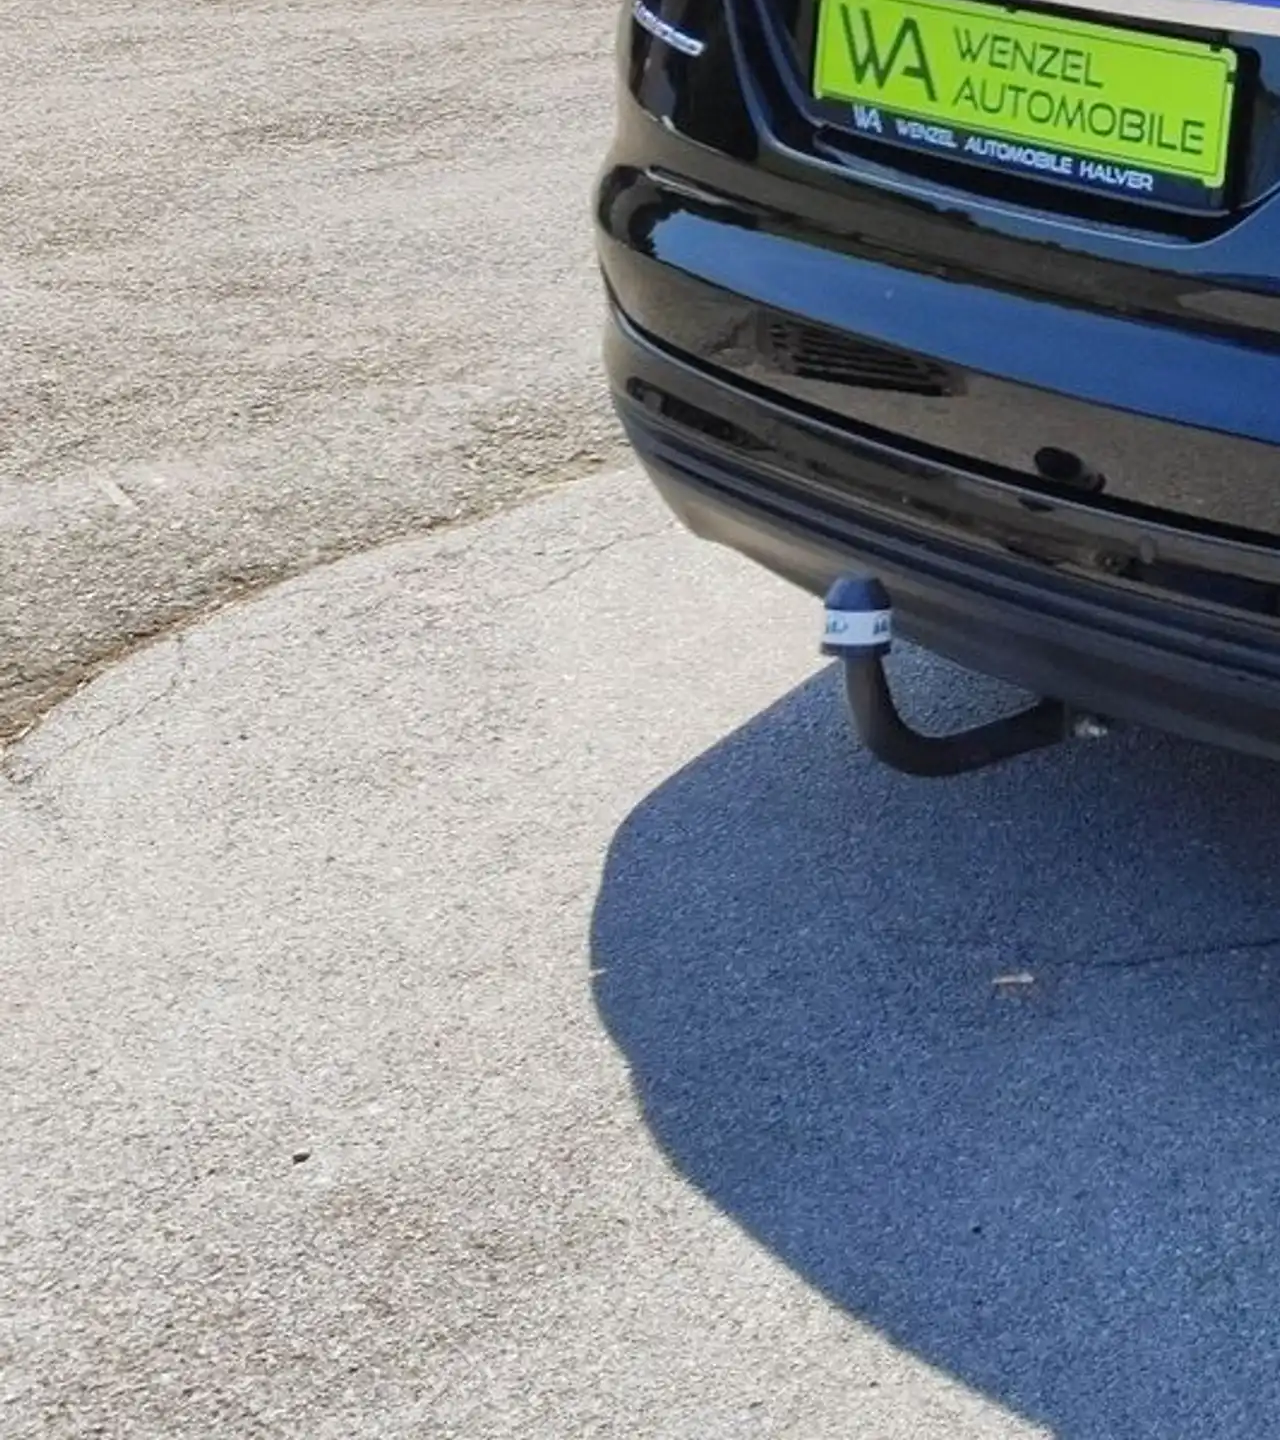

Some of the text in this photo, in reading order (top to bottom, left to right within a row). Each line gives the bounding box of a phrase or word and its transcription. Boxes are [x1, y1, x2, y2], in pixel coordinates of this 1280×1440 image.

[839, 3, 939, 103] WA
[952, 26, 1104, 89] WENZEL
[852, 105, 1154, 192] WA WENZEL AUTOMOBILE HALVER
[950, 75, 1206, 155] AUTOMOBILE
